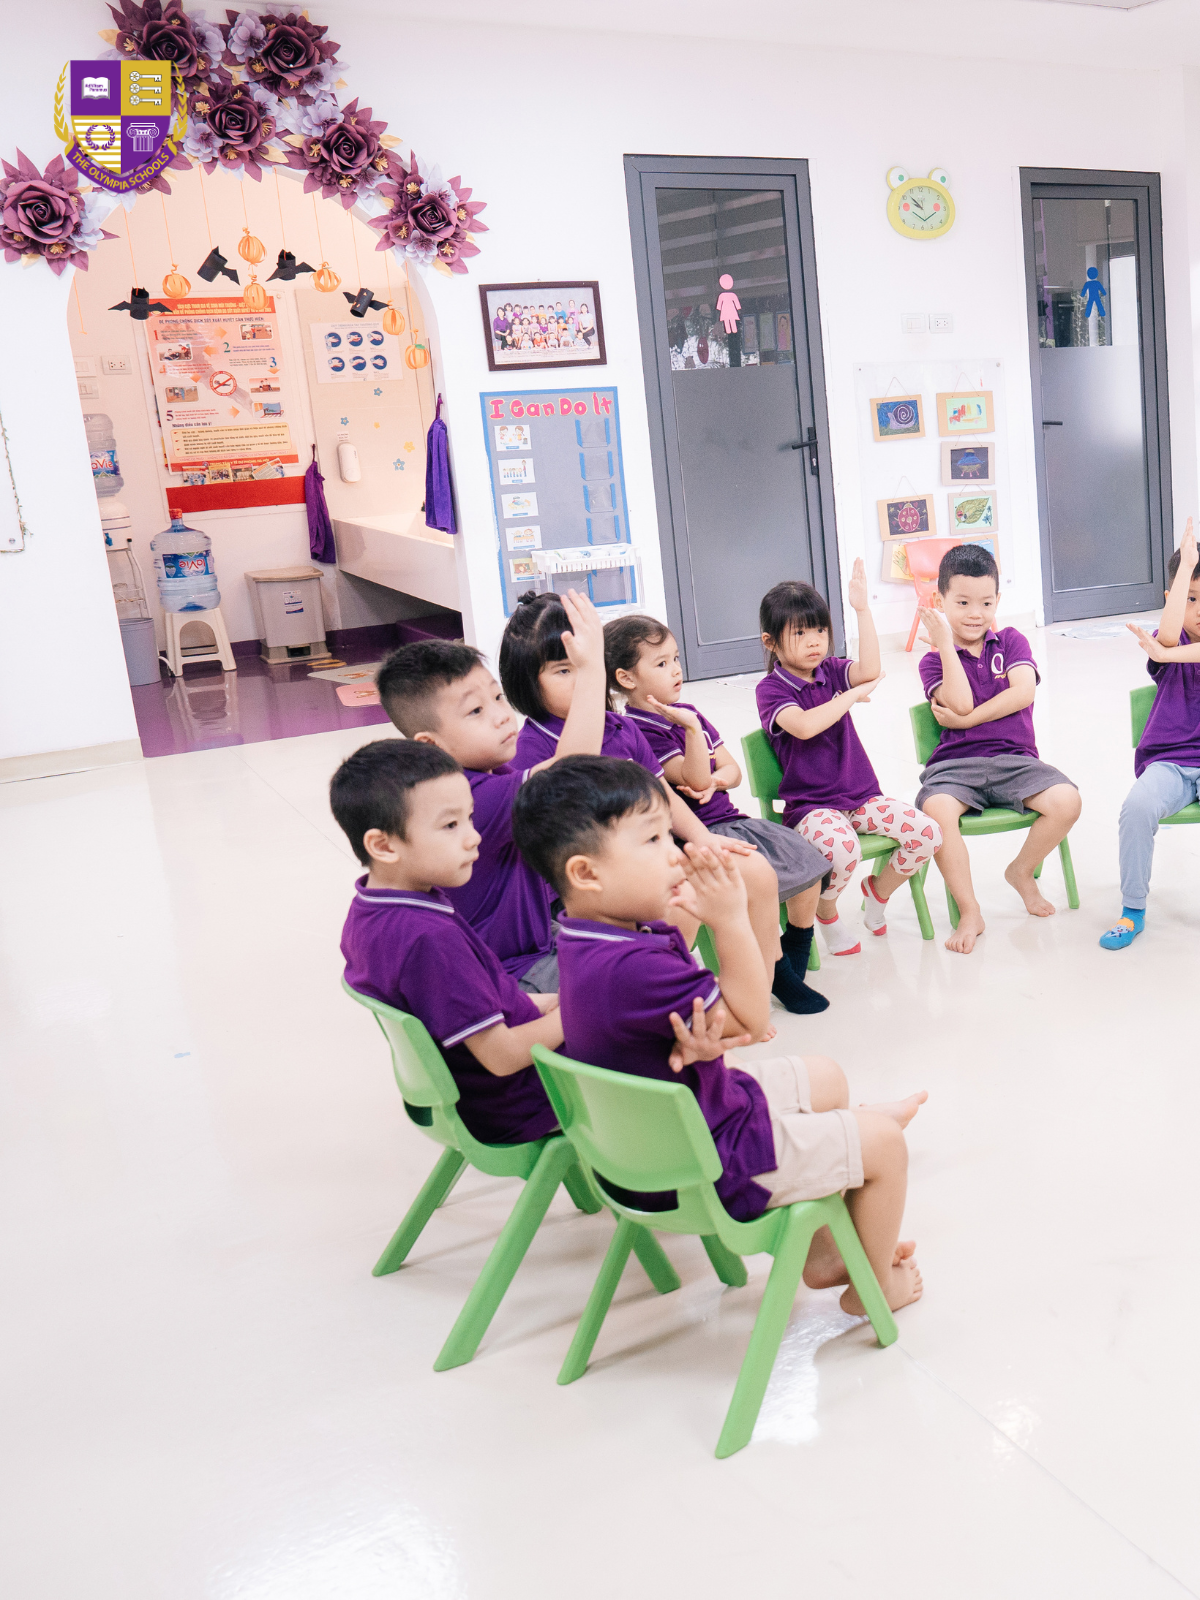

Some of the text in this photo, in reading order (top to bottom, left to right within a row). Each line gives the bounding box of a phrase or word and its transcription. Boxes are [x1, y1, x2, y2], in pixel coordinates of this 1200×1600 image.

[223, 342, 230, 353] 2
[270, 357, 277, 368] 3
[490, 398, 505, 419] I
[559, 397, 587, 416] Do
[166, 410, 174, 421] 5
[91, 459, 114, 469] aVie
[991, 653, 1004, 674] O
